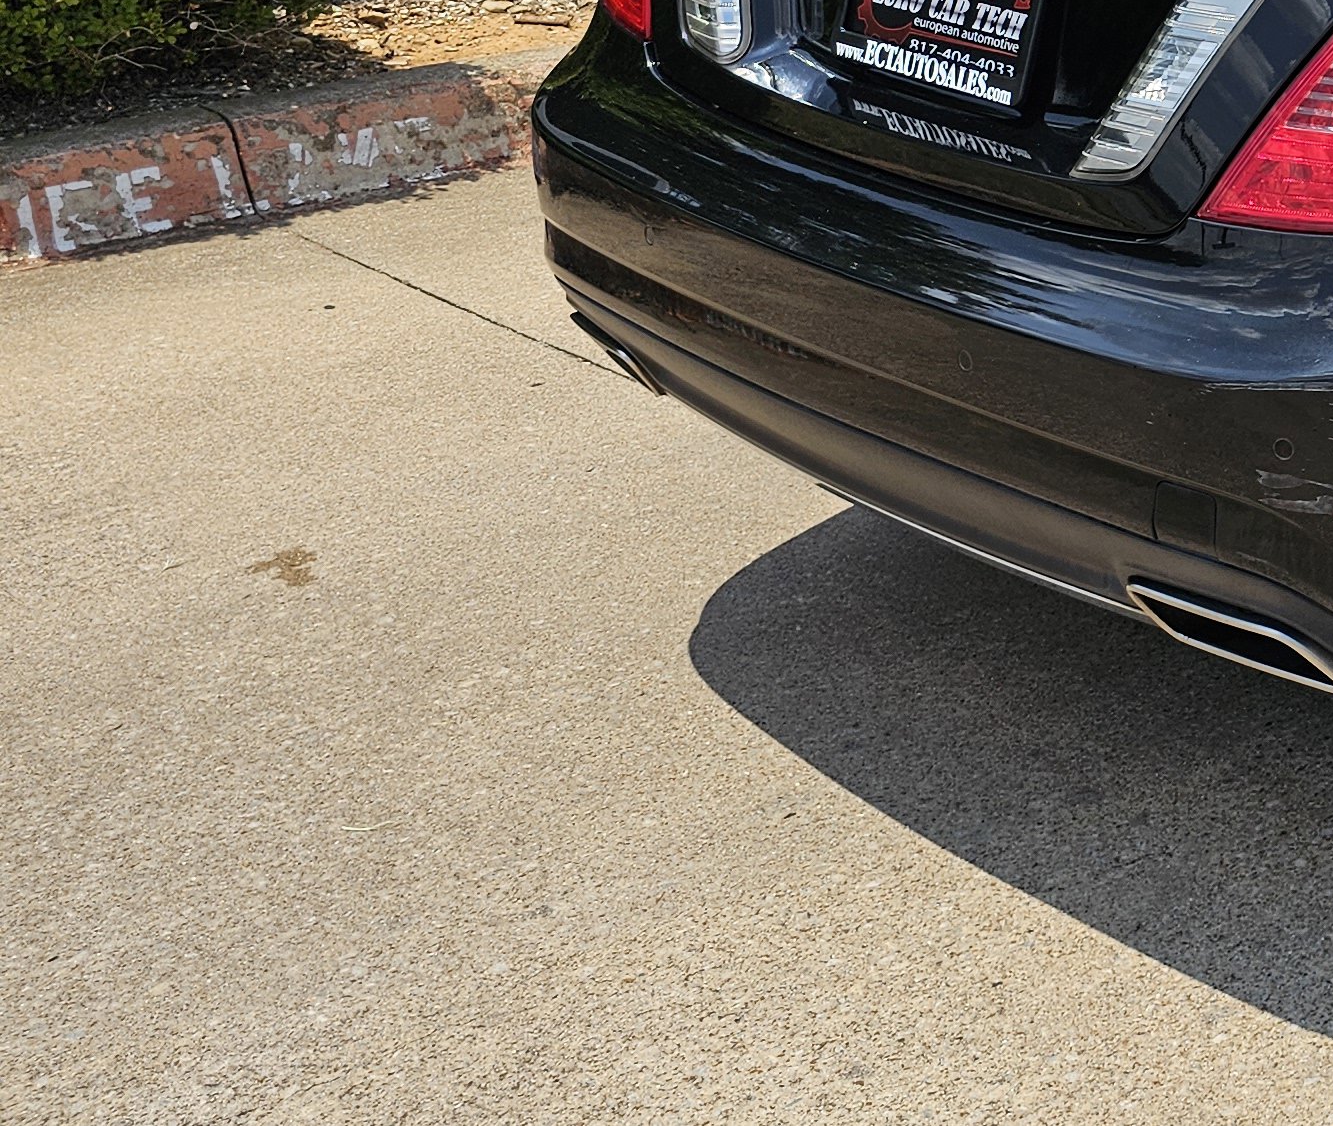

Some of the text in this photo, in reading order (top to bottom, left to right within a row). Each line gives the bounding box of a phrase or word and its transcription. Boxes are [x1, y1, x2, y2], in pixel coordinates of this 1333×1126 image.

[914, 17, 1020, 54] european automotive
[971, 2, 1029, 41] TECH
[835, 39, 1013, 106] www.ECTAUTOSALES.com
[908, 39, 1015, 78] 817-404-4033
